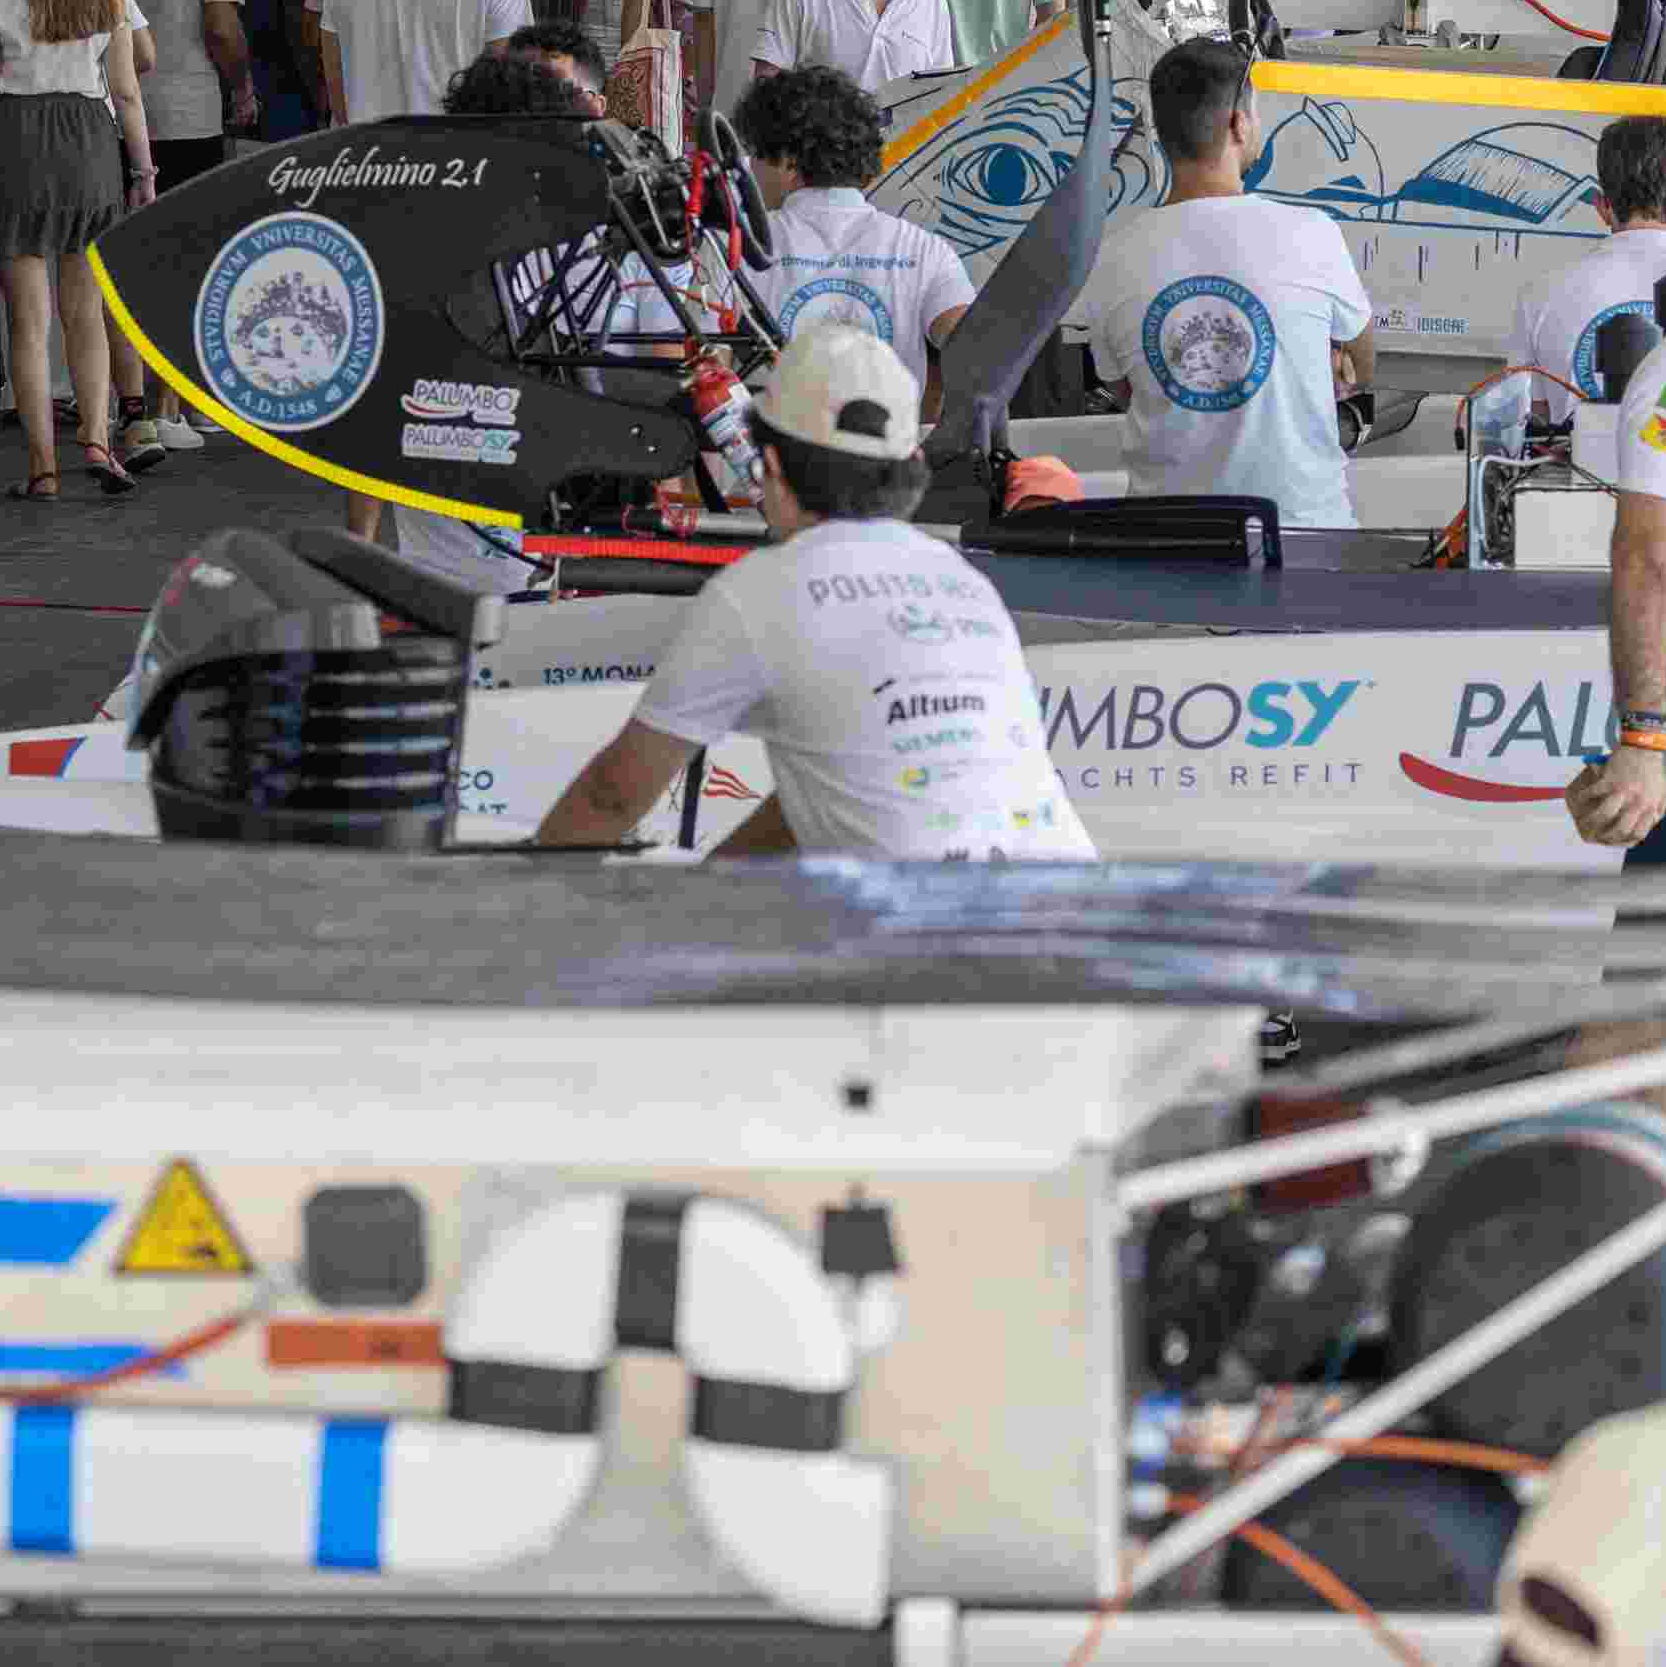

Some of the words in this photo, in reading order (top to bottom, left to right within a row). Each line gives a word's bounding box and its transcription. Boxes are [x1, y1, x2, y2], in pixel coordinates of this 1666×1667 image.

[268, 145, 437, 208] Guglielmino
[886, 692, 987, 726] Altium
[1229, 762, 1362, 787] REFIT
